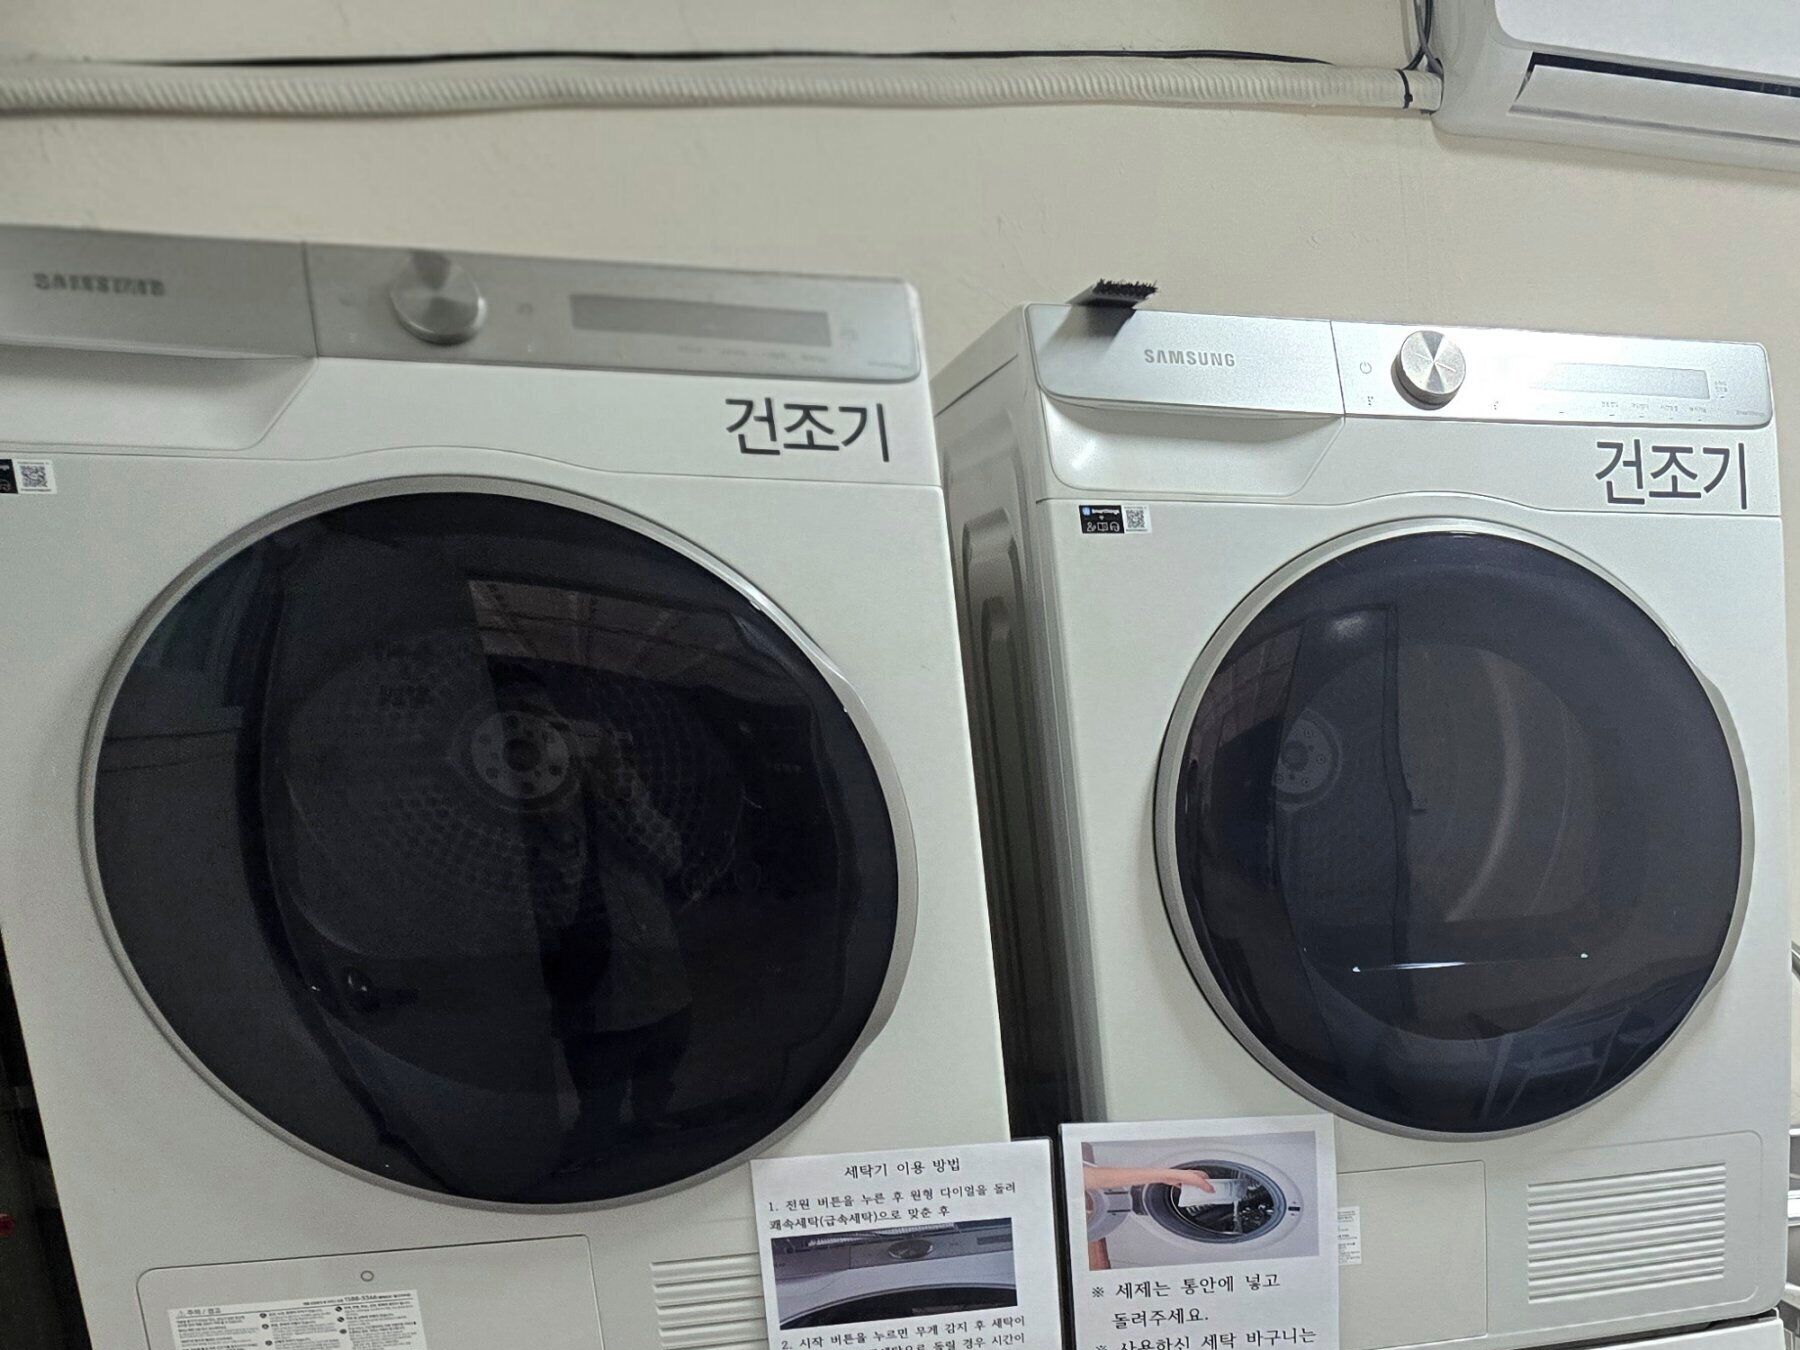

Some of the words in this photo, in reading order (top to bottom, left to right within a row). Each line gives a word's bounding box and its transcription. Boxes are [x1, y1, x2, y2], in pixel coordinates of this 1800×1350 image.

[1143, 347, 1237, 369] SAMSUNG
[726, 397, 890, 461] 건조기
[1595, 441, 1749, 509] 건조기
[844, 1163, 887, 1179] 세탁기
[896, 1160, 925, 1175] 이용
[932, 1156, 959, 1173] 방법
[768, 1201, 778, 1211] 1.
[785, 1198, 810, 1211] 전원
[817, 1195, 854, 1208] 버튼을
[861, 1192, 885, 1205] 누른
[892, 1190, 904, 1203] 후
[910, 1187, 933, 1201] 원형
[940, 1184, 987, 1198] 다이얼을
[907, 1207, 931, 1219] 맞춘
[938, 1205, 950, 1216] 후
[1115, 1280, 1171, 1299] 세제는
[1180, 1275, 1233, 1295] 통안에
[1245, 1273, 1280, 1290] 넣고
[1111, 1307, 1208, 1329] 돌려주세요.
[781, 1340, 792, 1350] 2.
[799, 1336, 824, 1349] 시작
[830, 1332, 867, 1345] 버튼을
[873, 1327, 908, 1341] 누르면
[915, 1324, 938, 1337] 무게
[945, 1321, 967, 1334] 감지
[974, 1320, 985, 1331] 후
[991, 1315, 1024, 1328] 세탁이
[962, 1336, 986, 1349] 경우
[991, 1332, 1024, 1345] 시간이
[1200, 1332, 1236, 1350] 세탁
[1246, 1327, 1316, 1347] 바구니는
